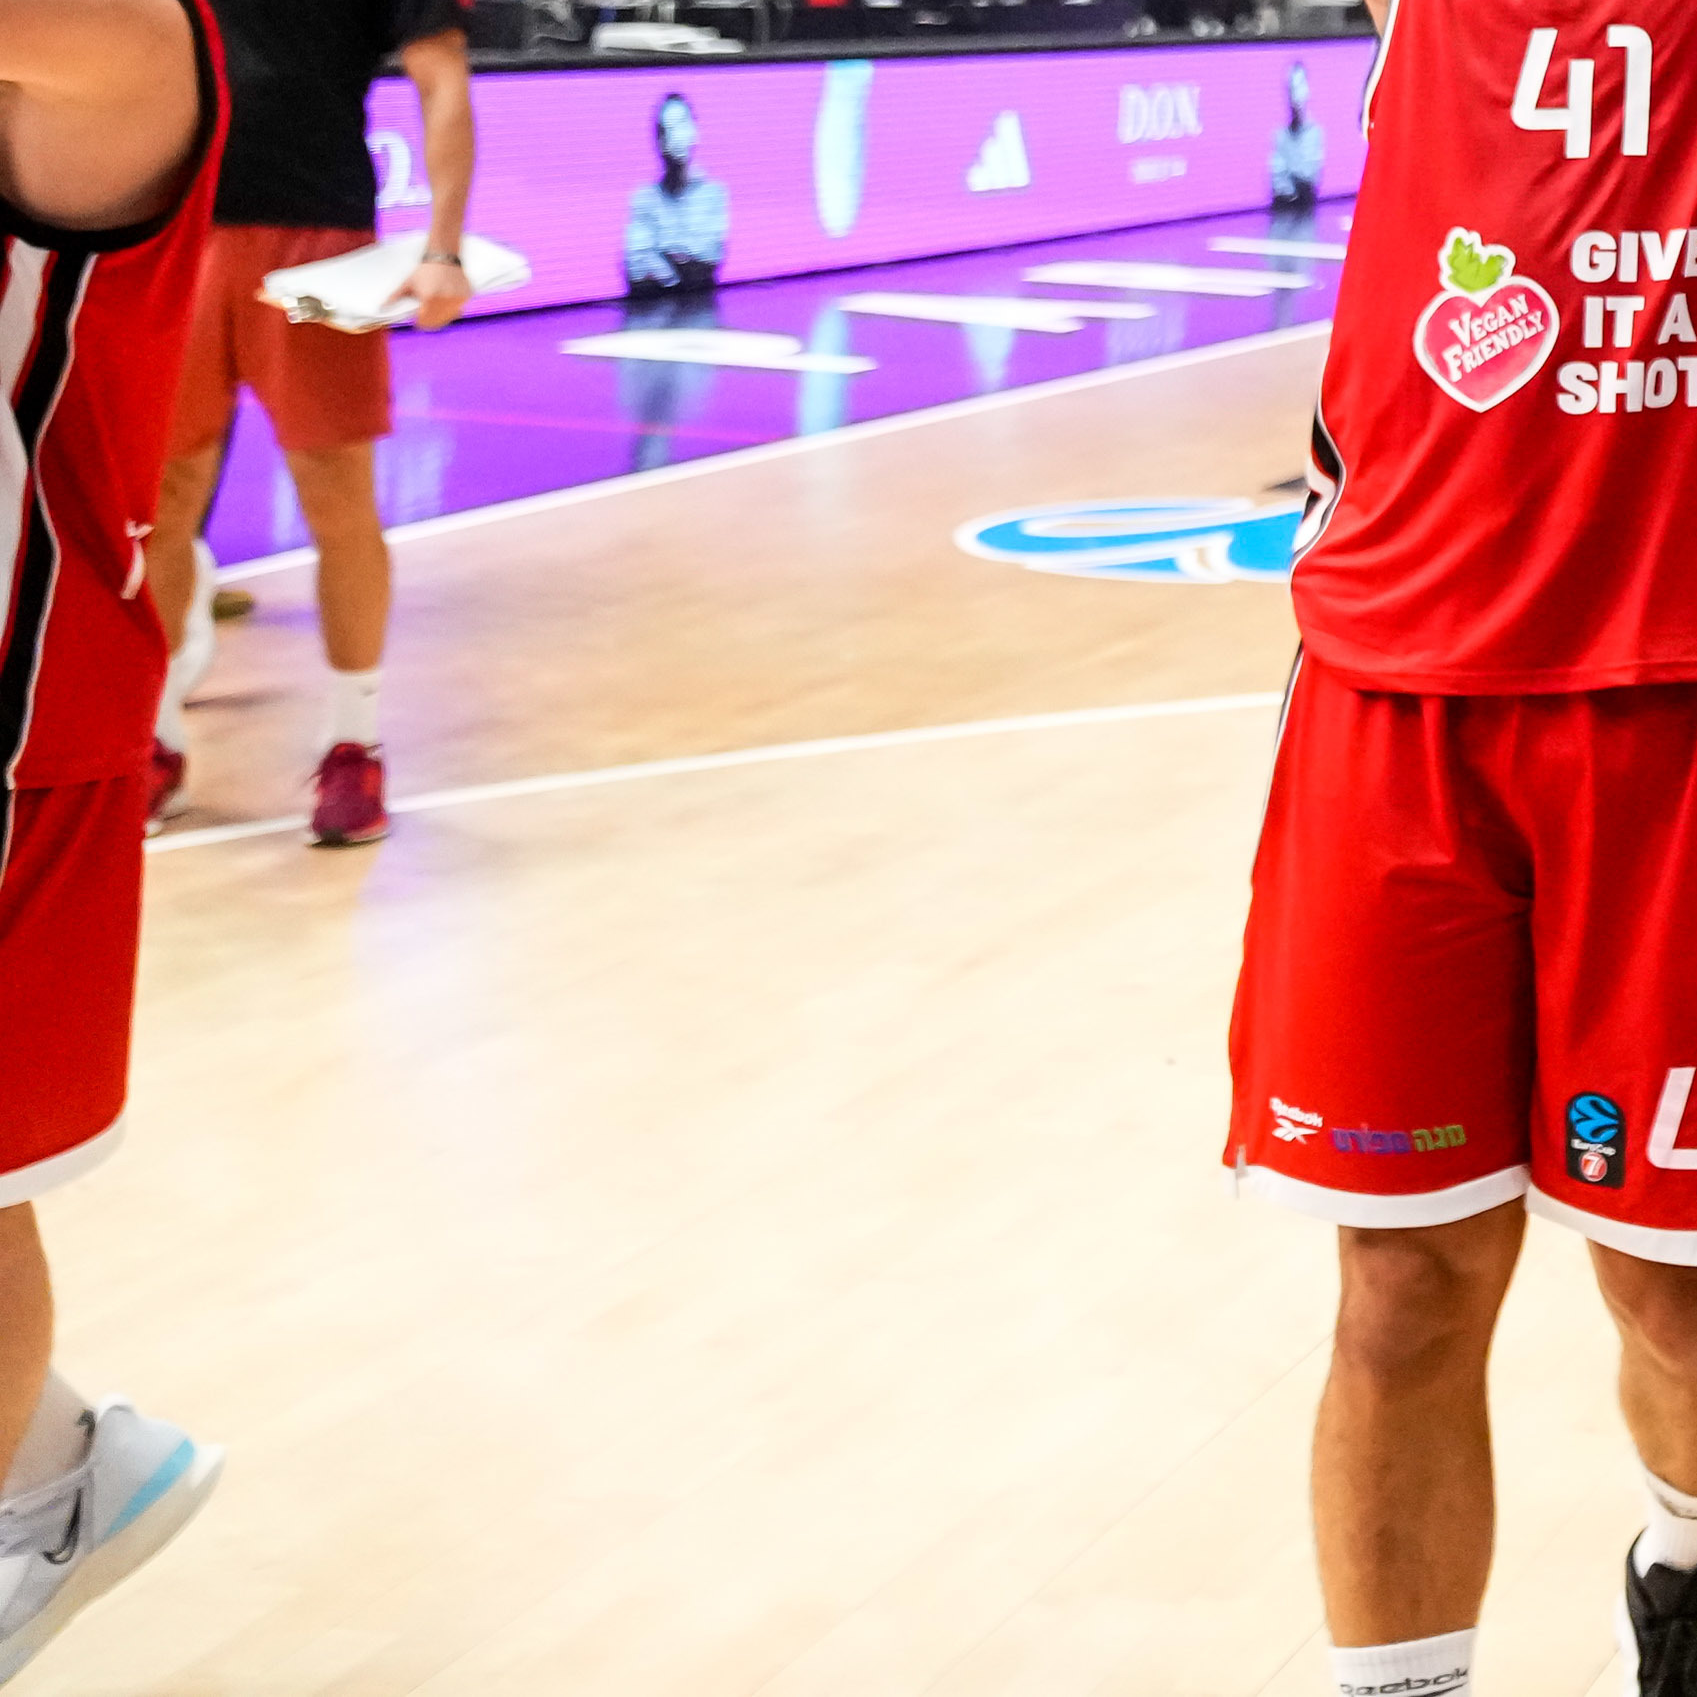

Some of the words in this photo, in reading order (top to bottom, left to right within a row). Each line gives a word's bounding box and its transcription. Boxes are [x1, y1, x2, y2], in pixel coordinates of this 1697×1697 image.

[1510, 24, 1653, 159] 41
[1441, 310, 1547, 383] FRIENDLY
[1449, 294, 1530, 348] VEGAN
[1583, 295, 1645, 348] IT
[1657, 292, 1697, 345] A
